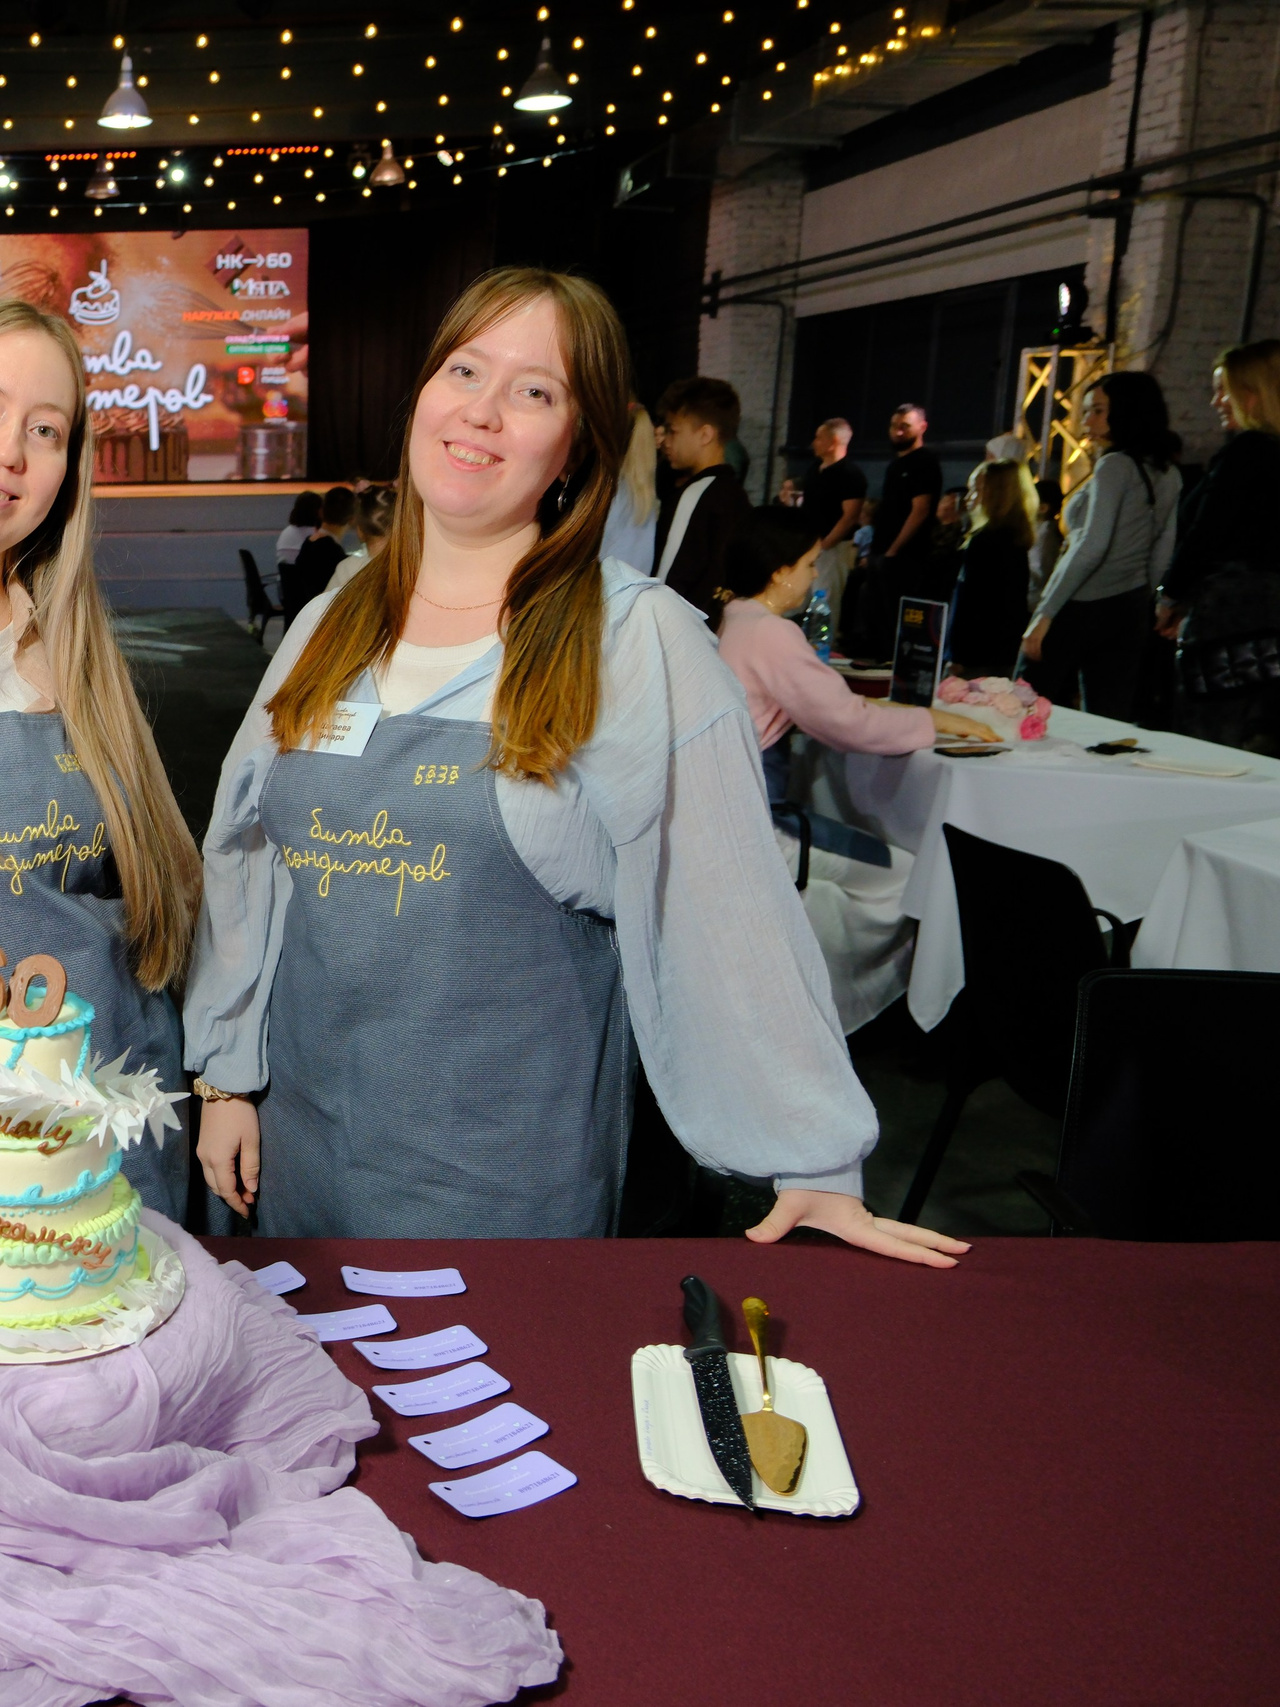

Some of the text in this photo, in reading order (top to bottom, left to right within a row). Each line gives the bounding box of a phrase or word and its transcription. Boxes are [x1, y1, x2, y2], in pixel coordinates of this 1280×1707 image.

[83, 330, 163, 375] тва
[86, 363, 214, 451] теров
[310, 808, 412, 849] битва
[282, 843, 451, 917] кондитеров
